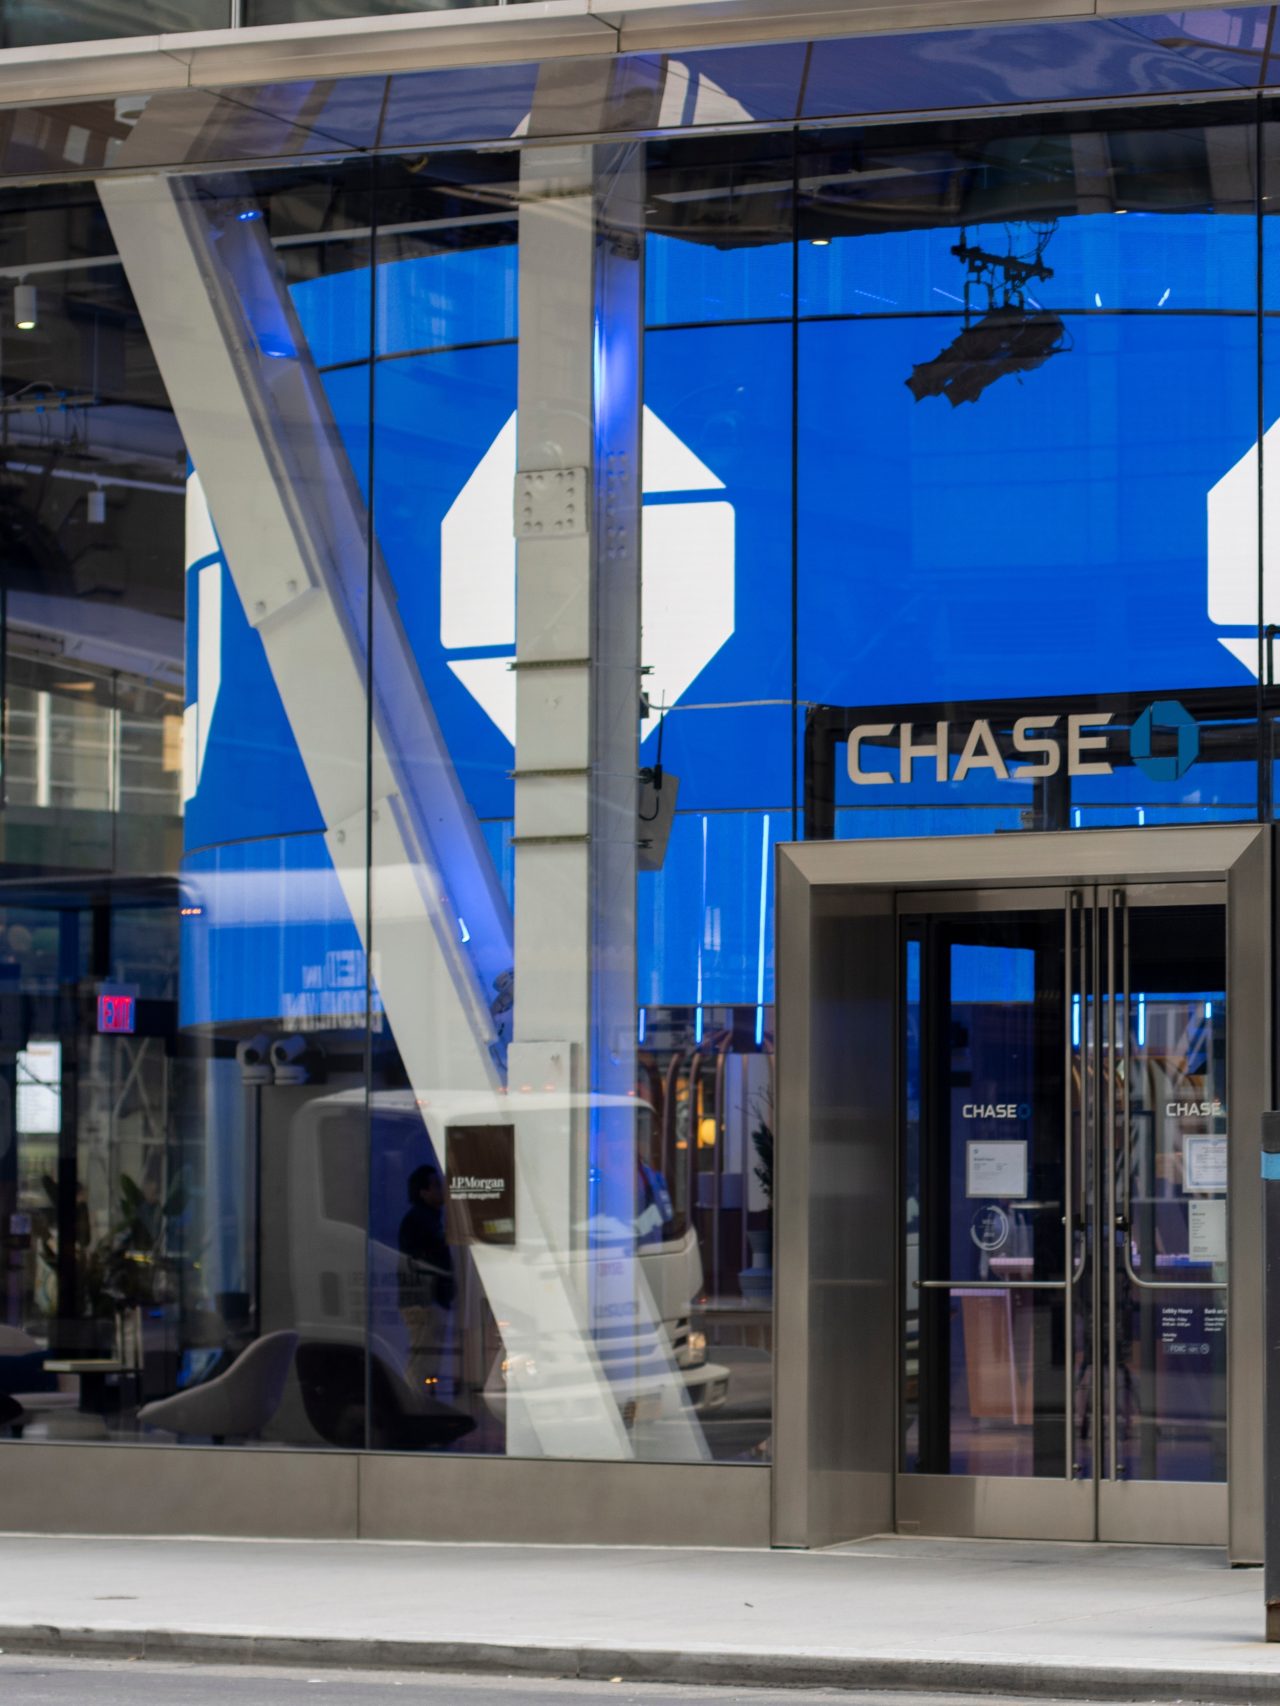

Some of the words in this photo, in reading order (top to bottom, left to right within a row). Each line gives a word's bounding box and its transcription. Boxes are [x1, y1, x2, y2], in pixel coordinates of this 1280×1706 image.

[847, 713, 1114, 785] CHASE
[962, 1104, 1017, 1119] CHASE
[1166, 1102, 1221, 1117] CHASE
